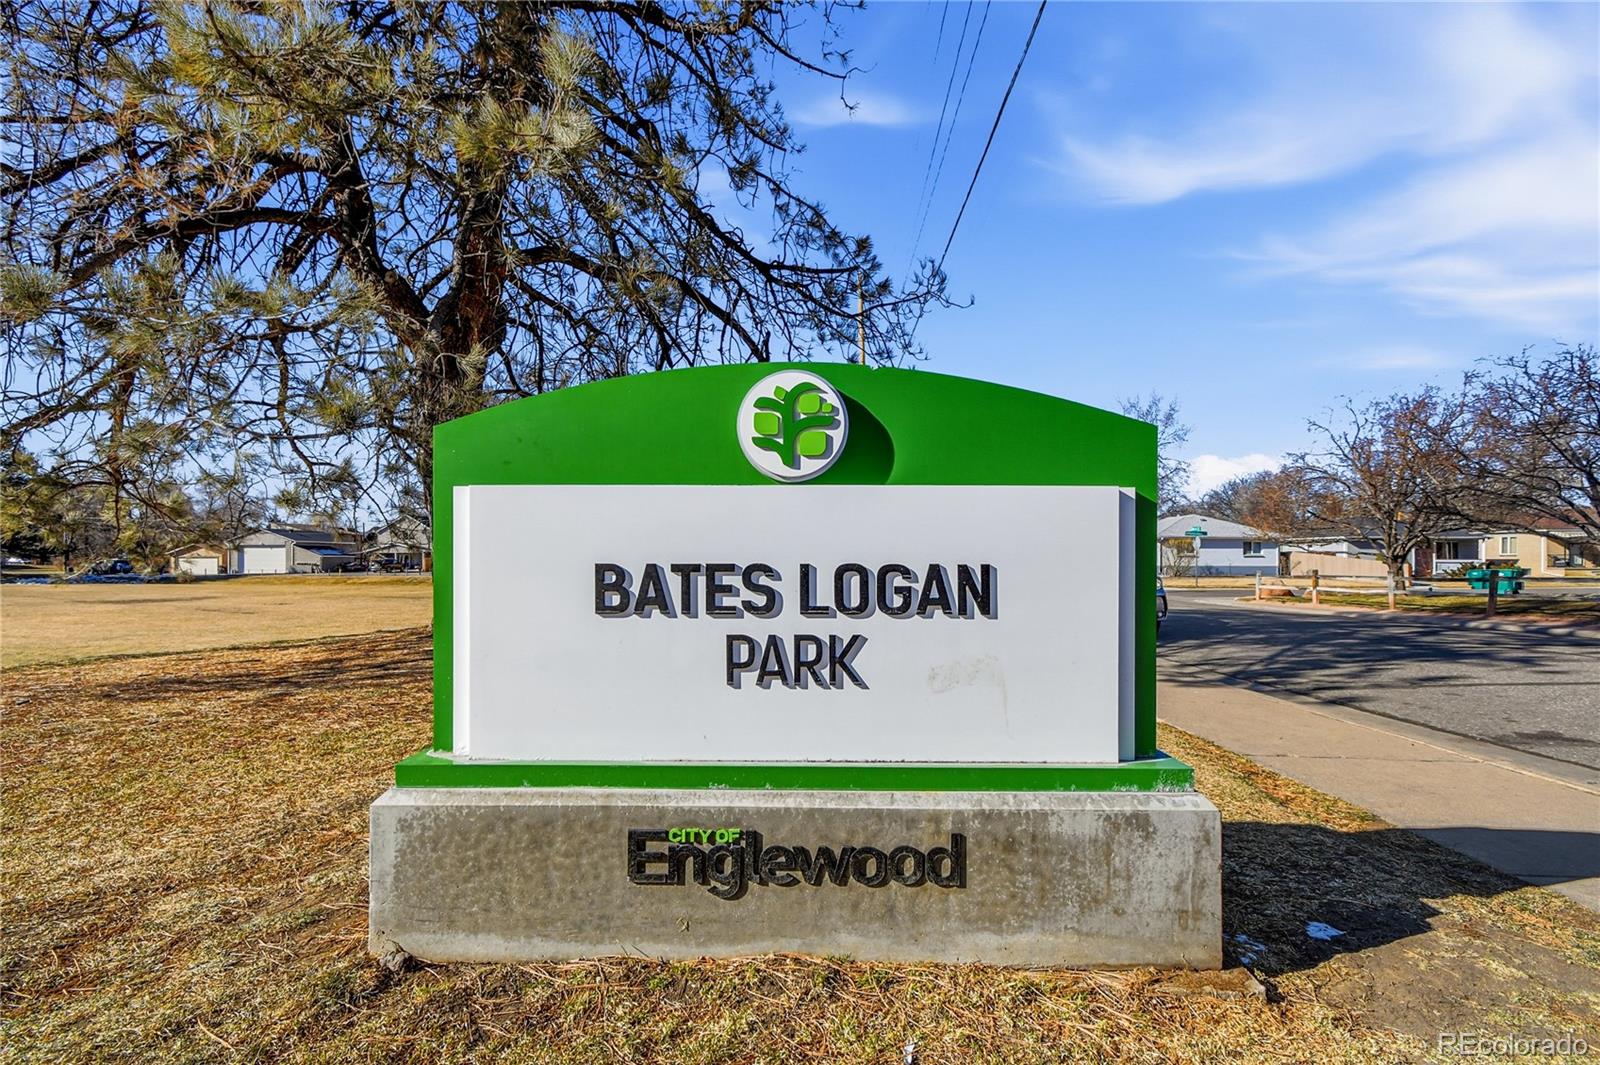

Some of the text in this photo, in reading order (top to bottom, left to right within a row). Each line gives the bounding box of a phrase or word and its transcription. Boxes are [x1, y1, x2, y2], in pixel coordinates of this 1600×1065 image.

[594, 563, 998, 619] BATES LOGAN
[726, 633, 869, 689] PARK
[668, 828, 740, 843] CITY OF
[627, 828, 967, 900] Englewood
